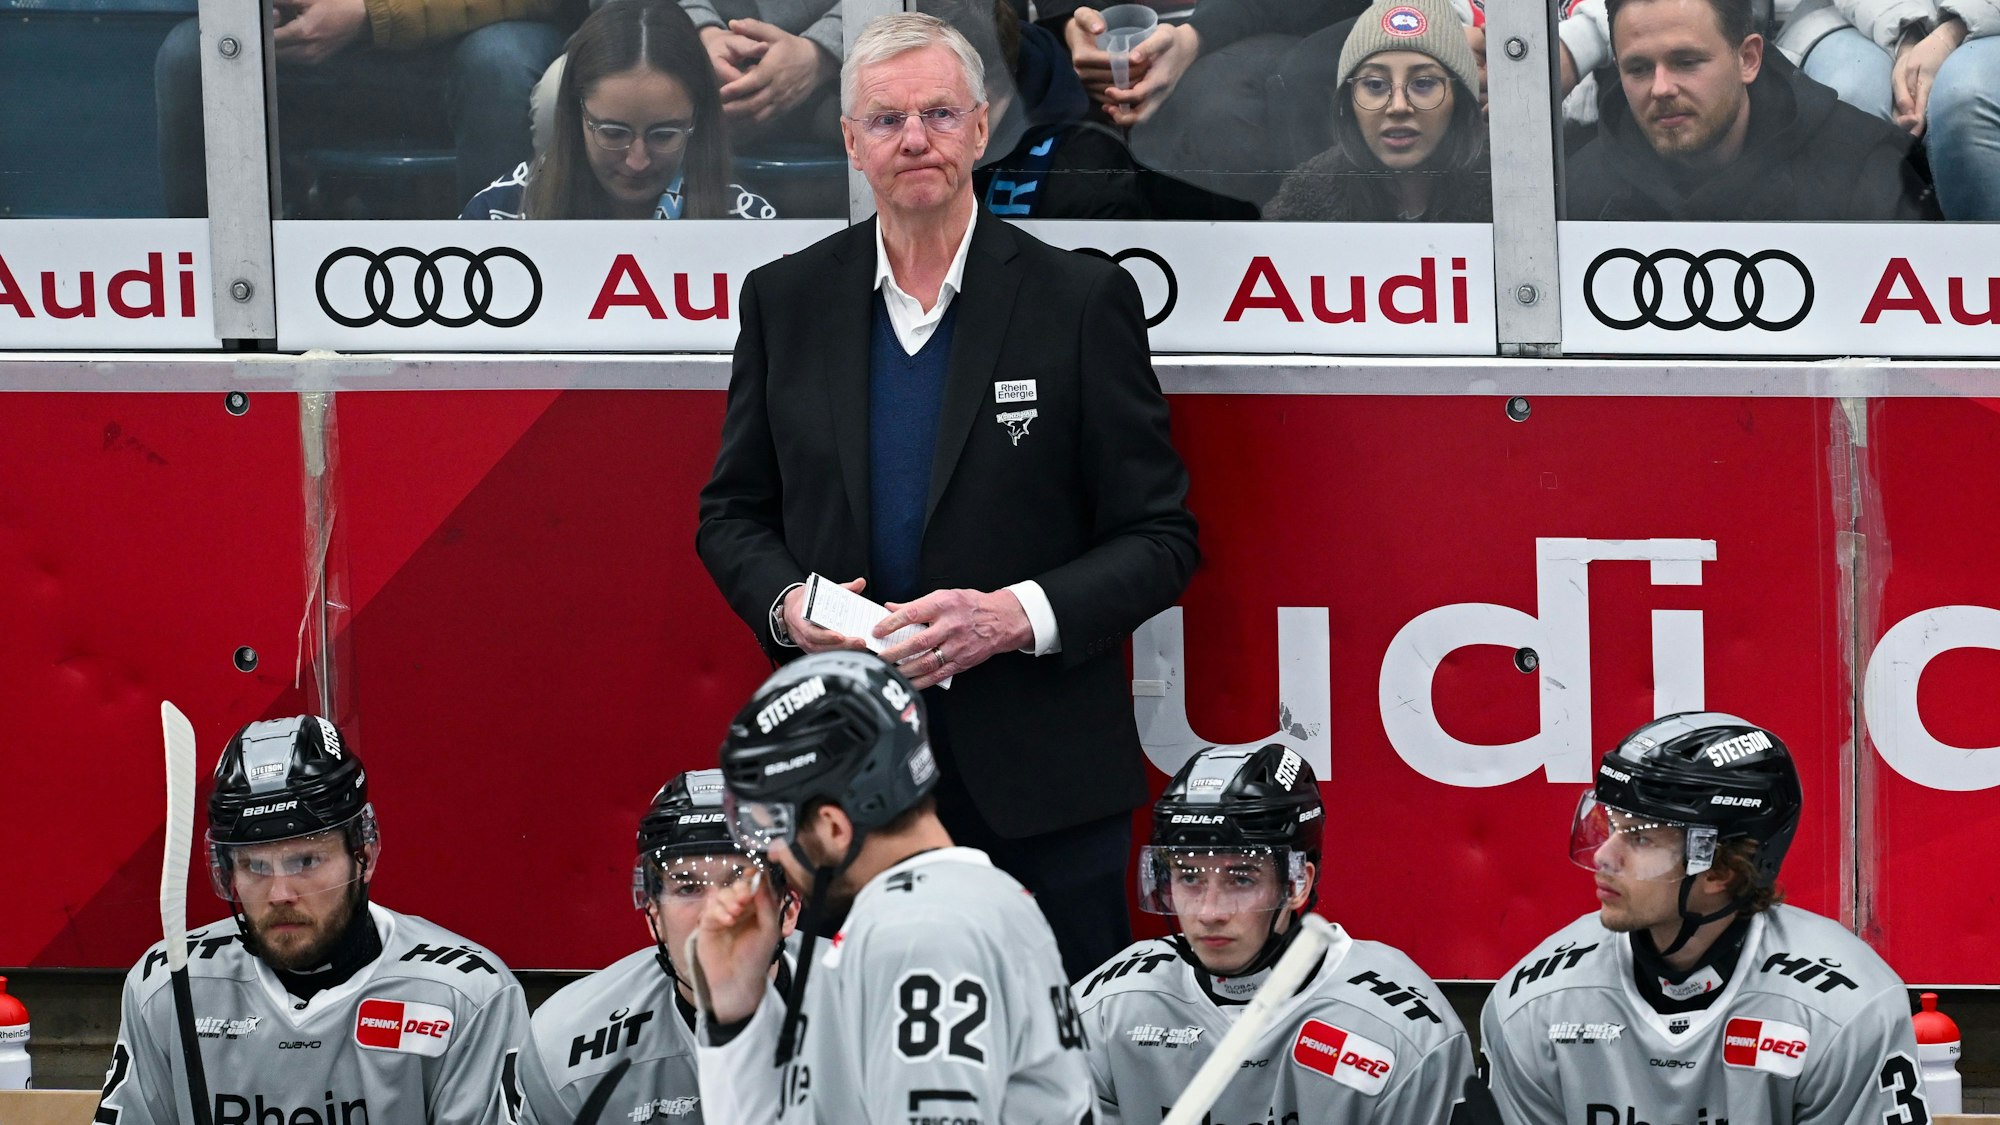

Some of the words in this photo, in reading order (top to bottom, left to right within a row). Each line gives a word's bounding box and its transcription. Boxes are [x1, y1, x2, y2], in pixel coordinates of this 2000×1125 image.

[587, 253, 730, 320] Au
[1223, 255, 1468, 324] Audi
[1859, 257, 2000, 326] Au
[998, 390, 1034, 400] Energie
[1001, 383, 1028, 392] Rhein
[1133, 537, 1706, 788] udi
[756, 675, 827, 735] STETSON
[1706, 730, 1773, 768] STETSON
[251, 763, 283, 777] STETSON
[1600, 764, 1631, 784] BAUER
[1190, 778, 1225, 788] STETSON
[242, 800, 298, 818] BAUER
[1710, 795, 1762, 808] BAUER
[1171, 814, 1225, 825] BAUER
[404, 1019, 450, 1039] DEL
[894, 969, 990, 1069] 82
[1760, 1038, 1807, 1059] DEL
[1340, 1051, 1390, 1078] DEL
[1879, 1052, 1931, 1125] 3
